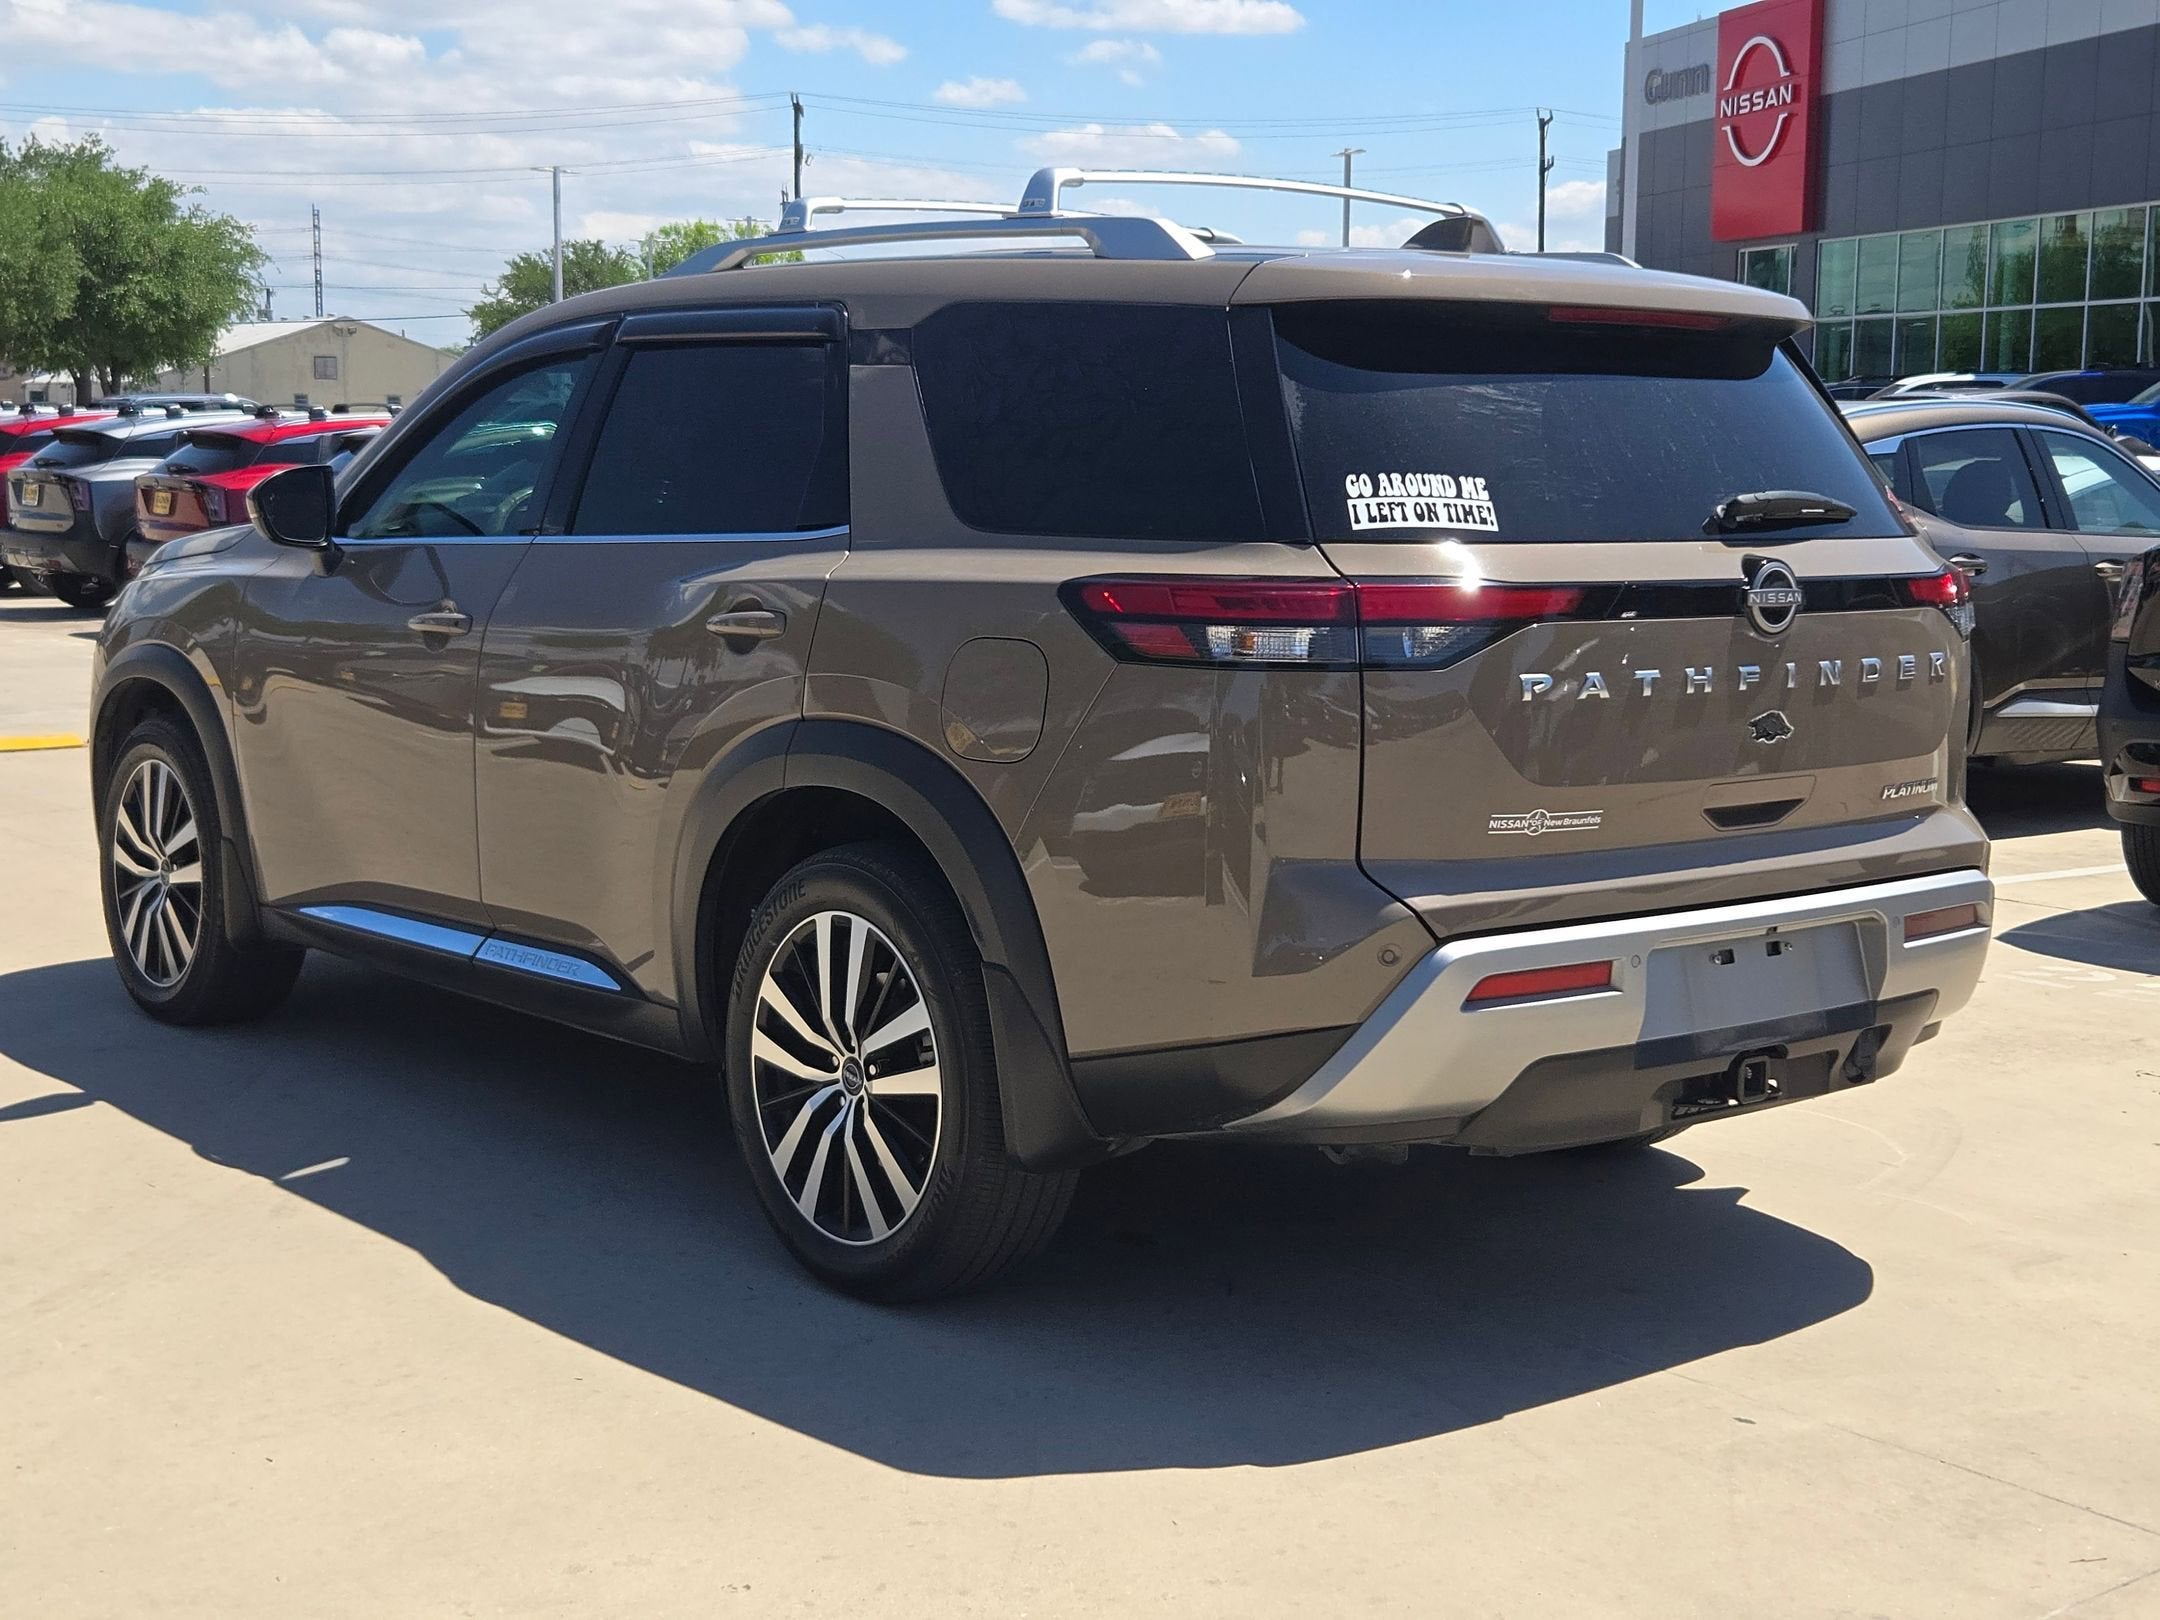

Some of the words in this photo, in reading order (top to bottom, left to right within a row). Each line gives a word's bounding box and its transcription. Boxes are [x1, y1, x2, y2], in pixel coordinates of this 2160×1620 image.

[1720, 84, 1792, 119] NISSAN
[1345, 473, 1373, 498] GO
[1378, 472, 1457, 498] AROUND
[1459, 475, 1490, 501] ME
[1352, 503, 1361, 525] I
[1365, 502, 1409, 524] LEFT
[1413, 501, 1440, 523] ON
[1443, 503, 1495, 527] TIME!
[1749, 591, 1802, 605] NISSAN
[1518, 652, 1946, 701] PATHFINDER
[1881, 778, 1938, 800] PLATINUM
[1488, 819, 1529, 829] NISSAN
[1543, 818, 1564, 827] New
[1563, 815, 1602, 826] Braunfels
[484, 942, 582, 976] PATHFINDER
